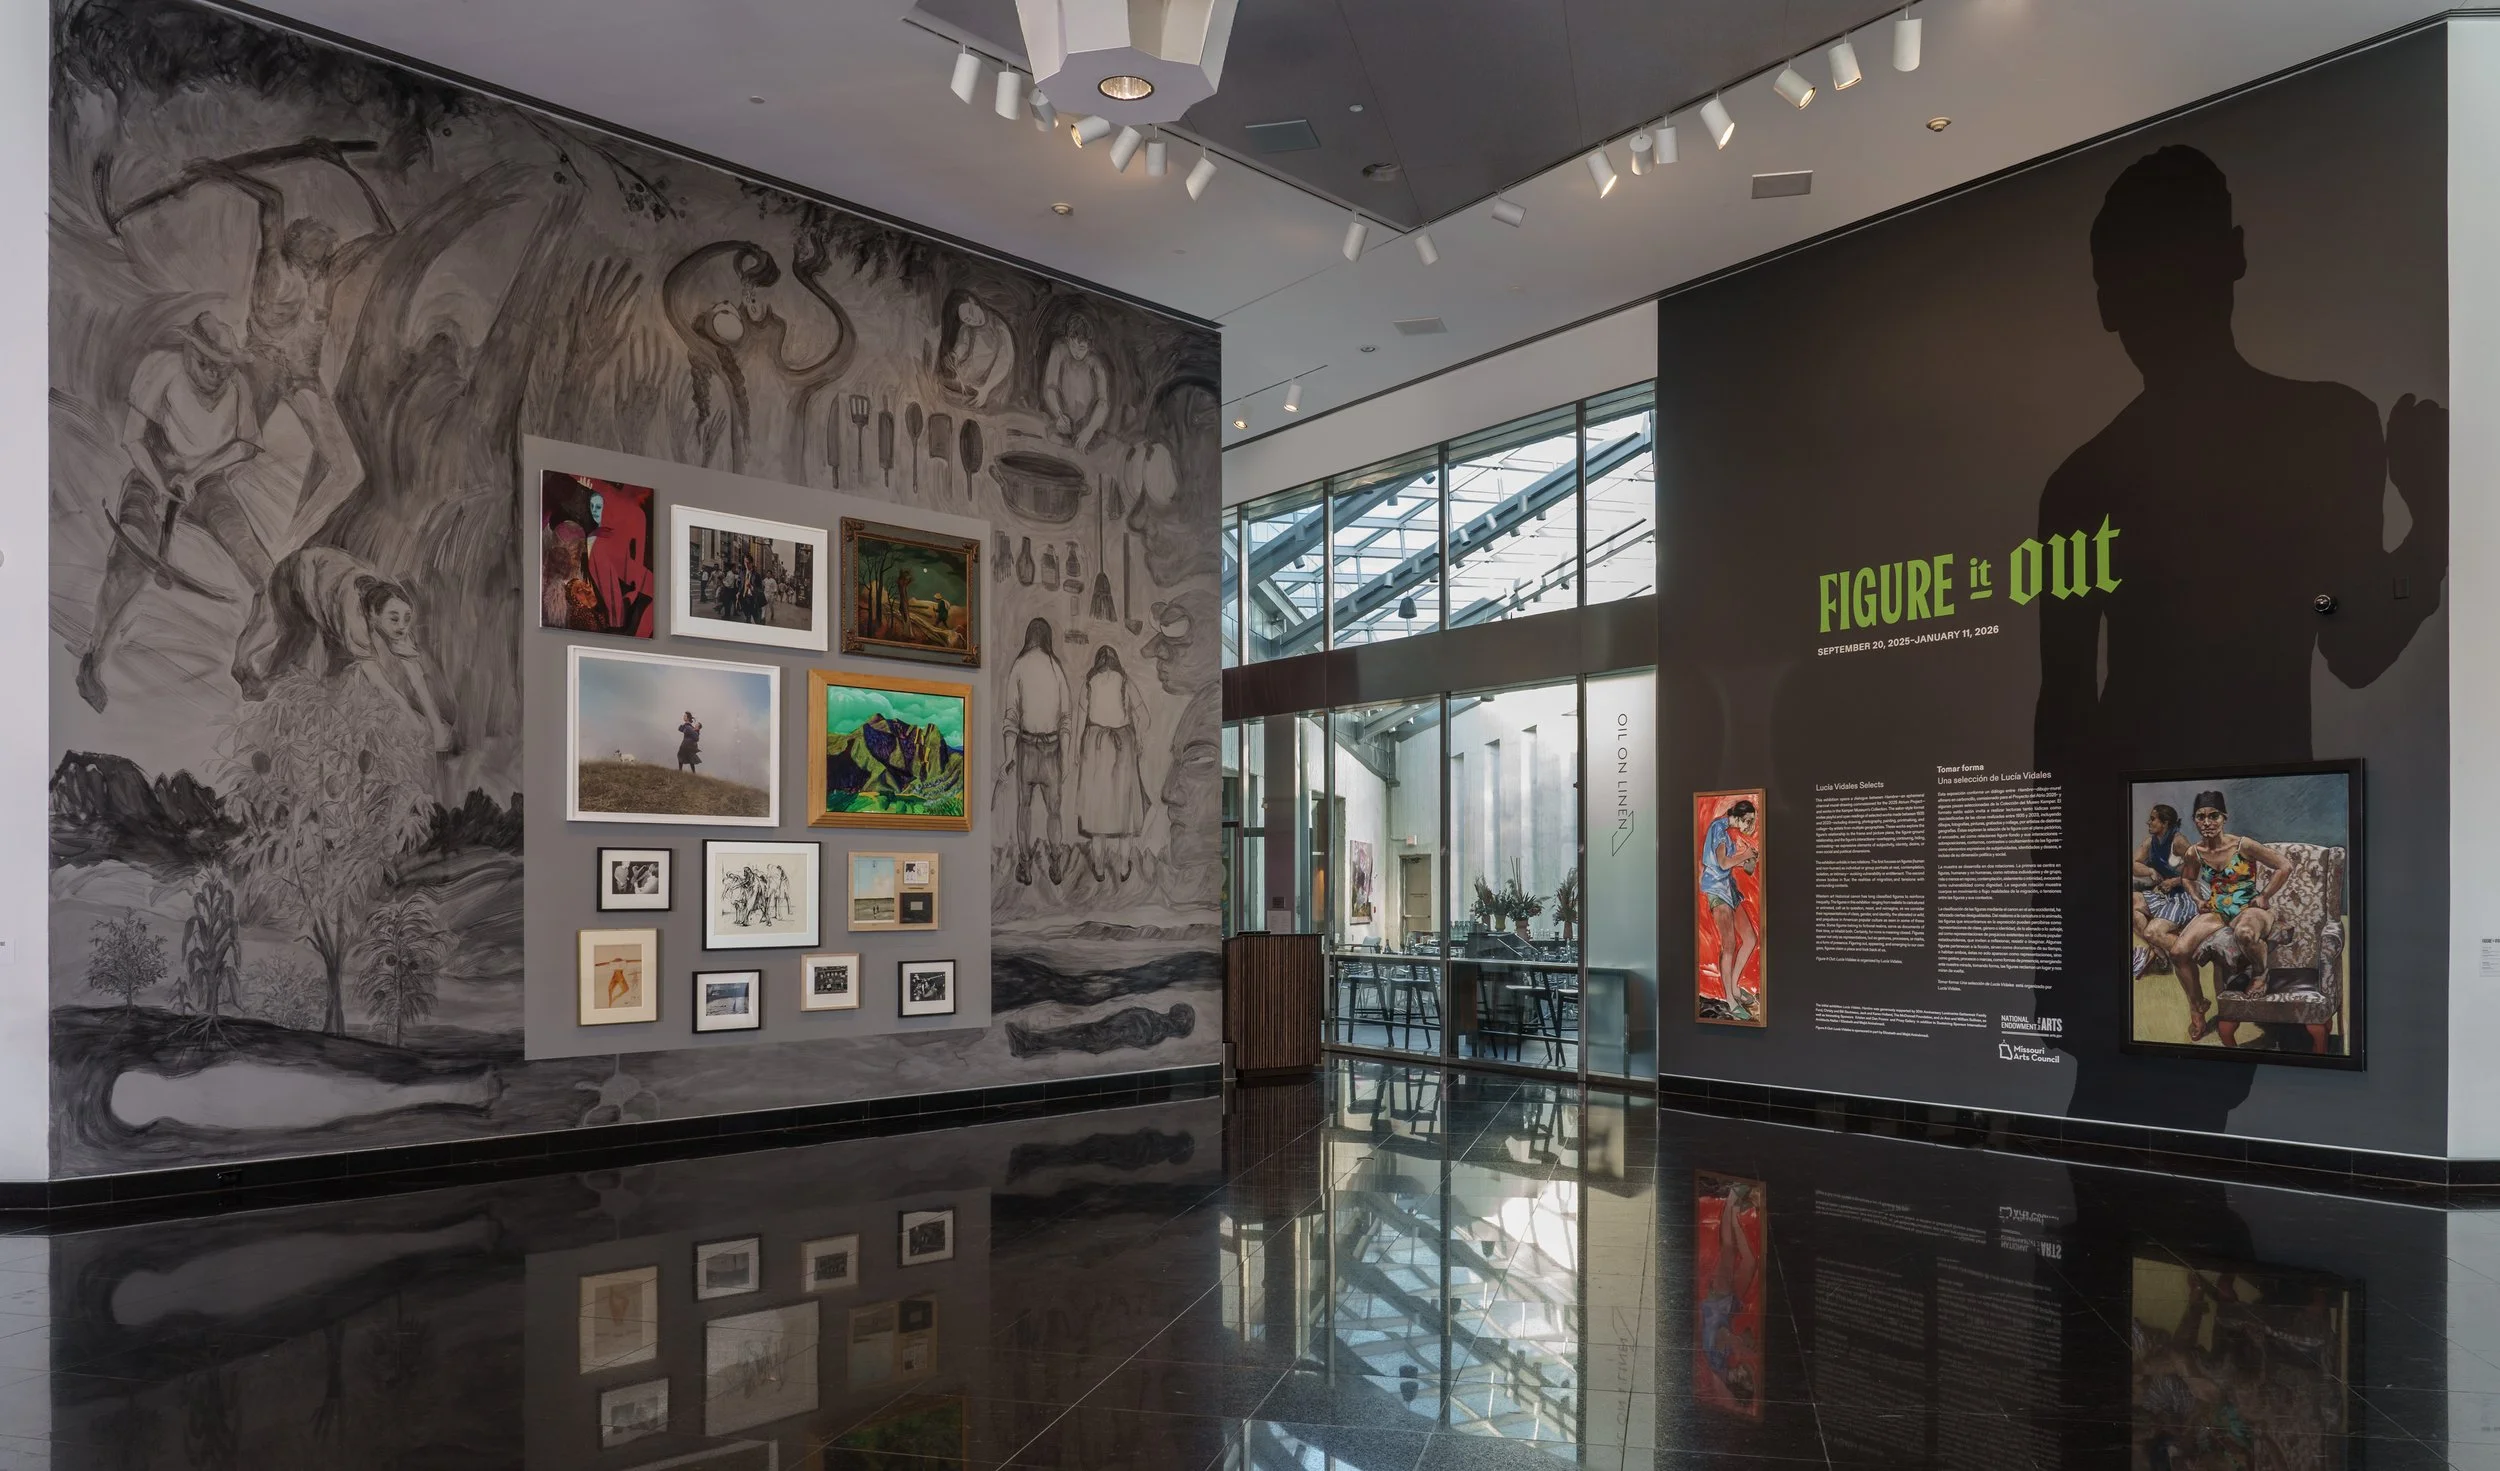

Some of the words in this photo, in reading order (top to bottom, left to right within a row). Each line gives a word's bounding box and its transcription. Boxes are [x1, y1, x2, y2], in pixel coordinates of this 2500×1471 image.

[1819, 553, 1955, 633] FIGURE
[1969, 557, 1992, 600] it
[2008, 513, 2122, 606] out
[1817, 642, 1871, 656] SEPTEMBER
[1872, 640, 1886, 650] 20,
[1962, 628, 1973, 639] 11,
[1974, 624, 1999, 636] 2026
[1618, 714, 1627, 741] OIL
[1618, 747, 1627, 773] ON
[1962, 764, 1984, 772] forma
[1954, 775, 1988, 784] selección
[1990, 774, 1999, 782] de
[2022, 771, 2052, 780] Vidales
[1618, 781, 1627, 830] LINEN
[2001, 1022, 2037, 1030] ENDOWMENT
[2041, 1018, 2062, 1032] ARTS
[2014, 1045, 2045, 1054] Missouri
[2014, 1053, 2030, 1061] Arts
[2031, 1054, 2060, 1063] Council
